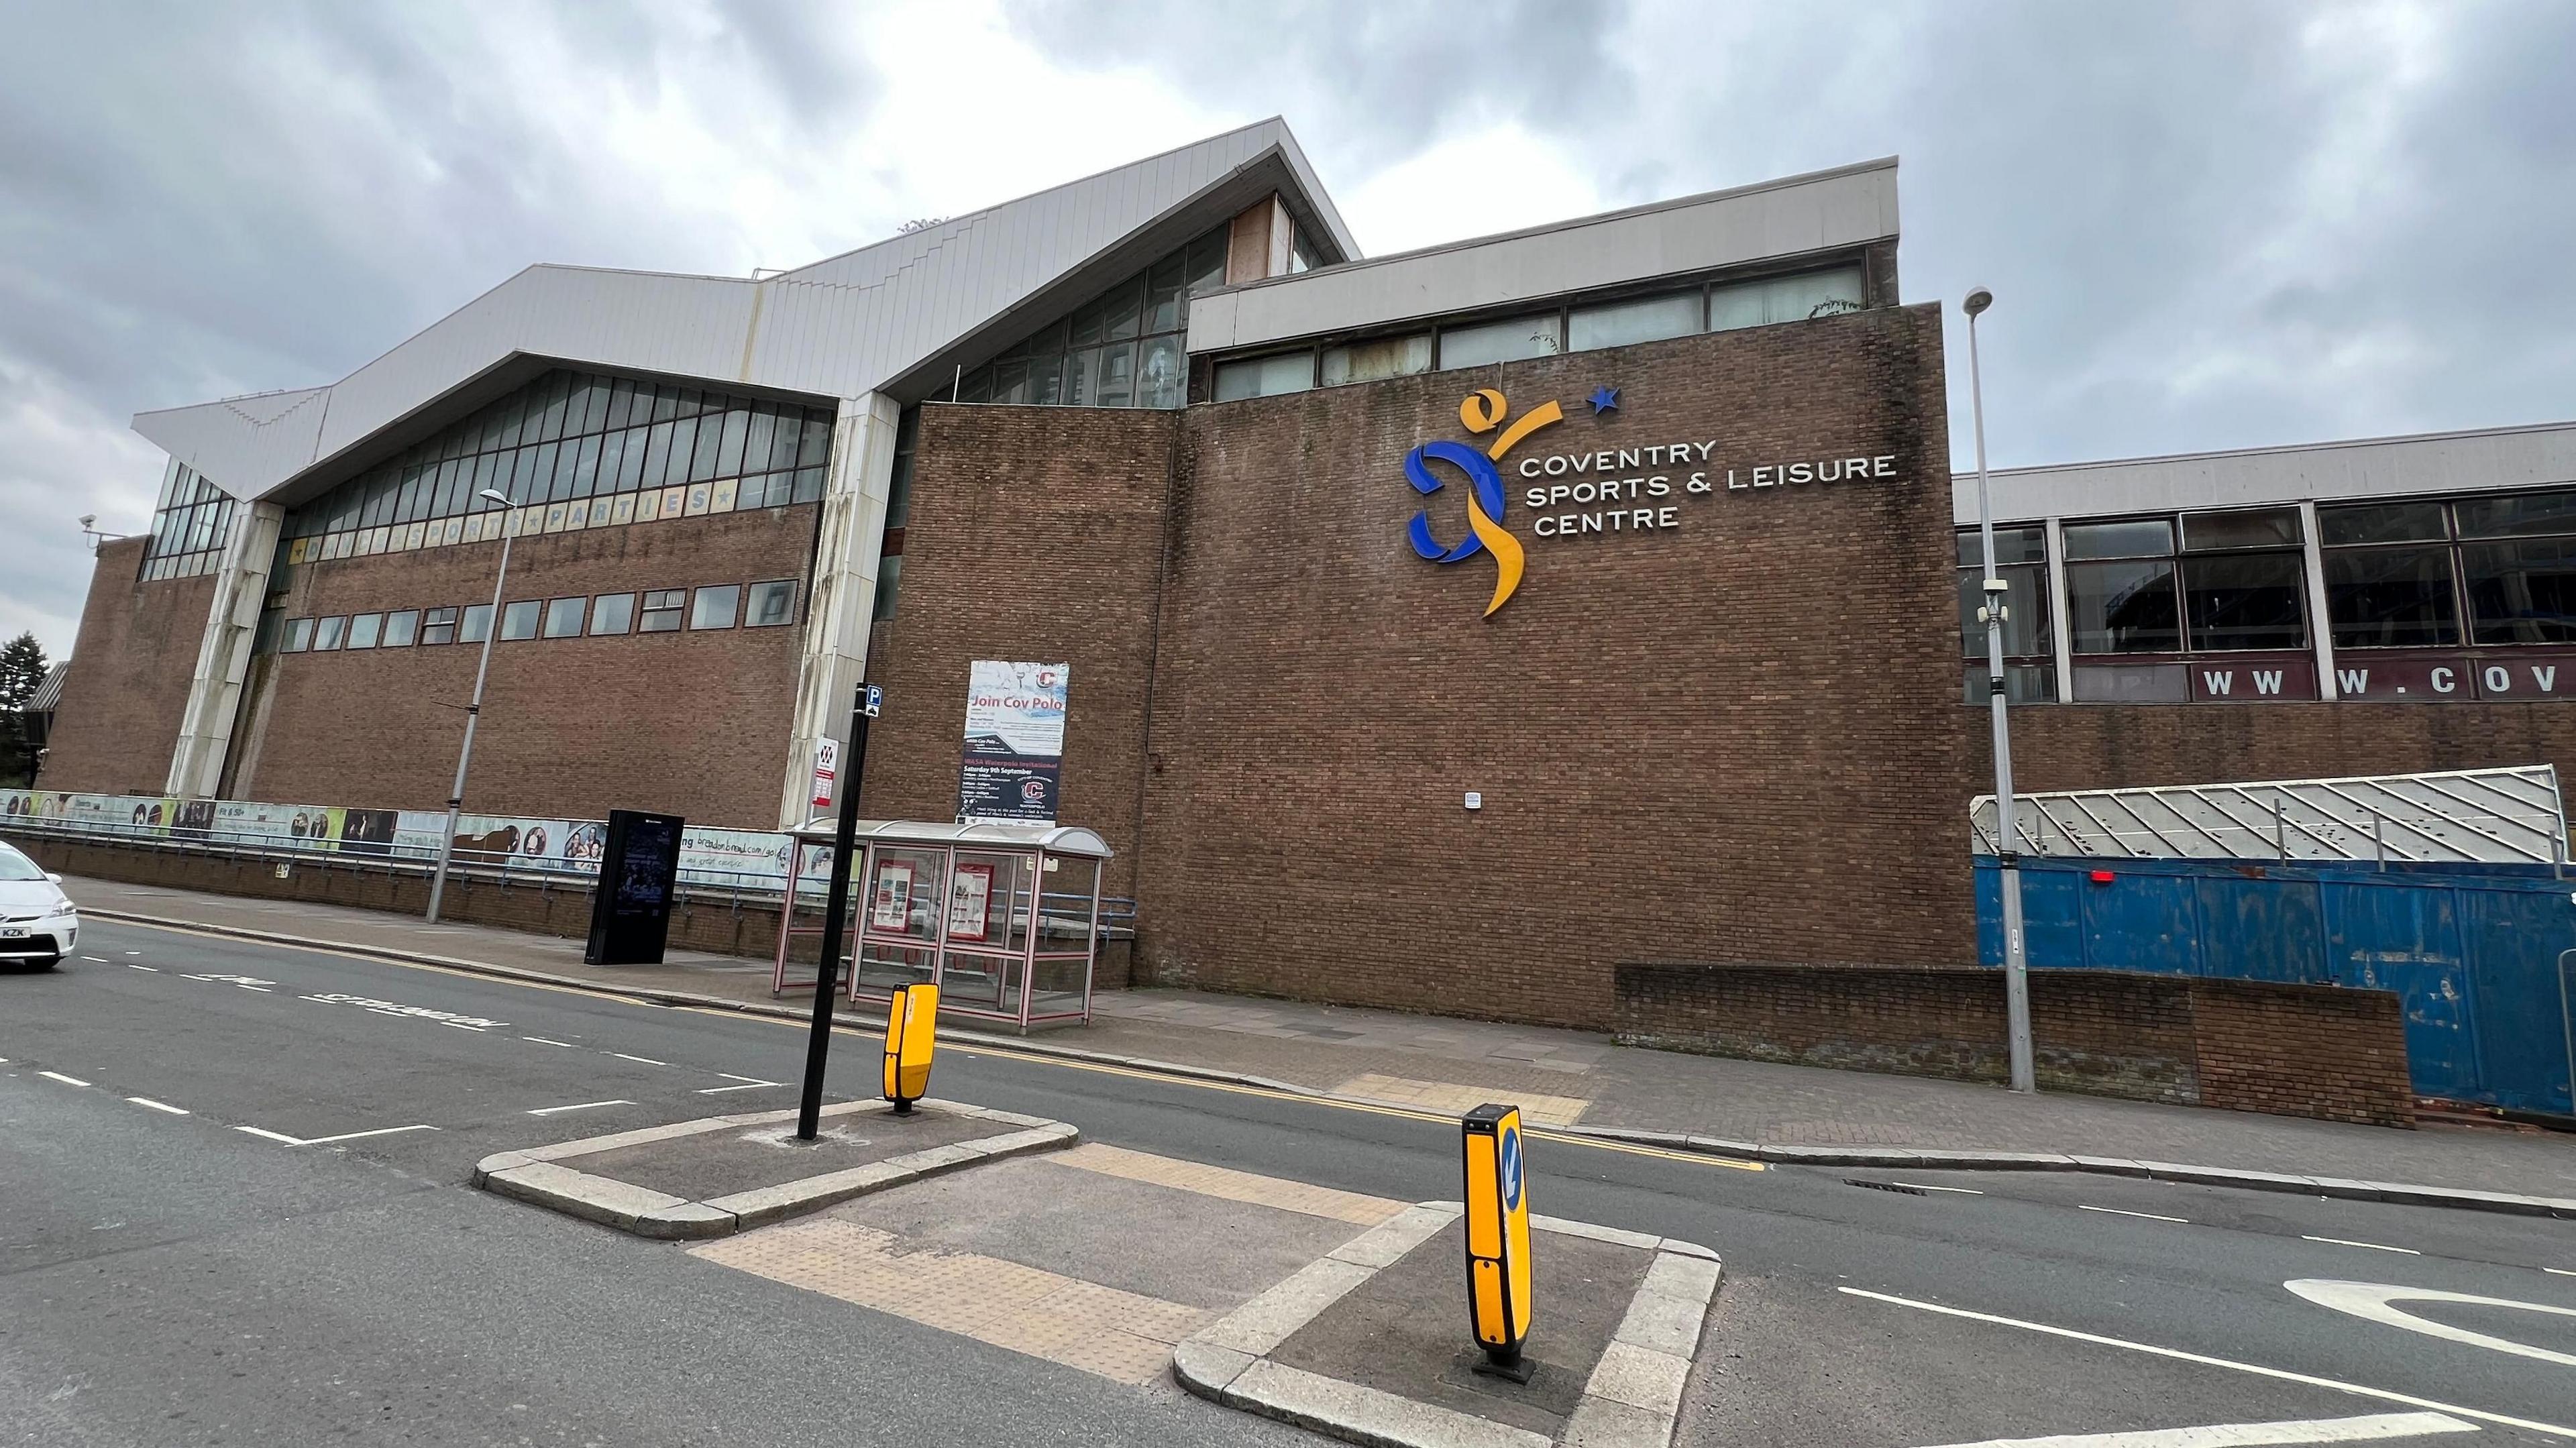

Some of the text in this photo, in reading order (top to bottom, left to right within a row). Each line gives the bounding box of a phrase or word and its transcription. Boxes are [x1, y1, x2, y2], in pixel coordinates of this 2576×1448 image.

[1519, 439, 1717, 478] COVENTRY
[1525, 455, 1898, 508] SPORTS & LEISURE
[549, 489, 708, 527] PARTIES
[1534, 506, 1679, 537] CENTRE
[869, 689, 880, 703] P
[972, 695, 1063, 710] Join Cov Polo
[964, 765, 989, 774] Saturday
[3, 928, 24, 937] KZK
